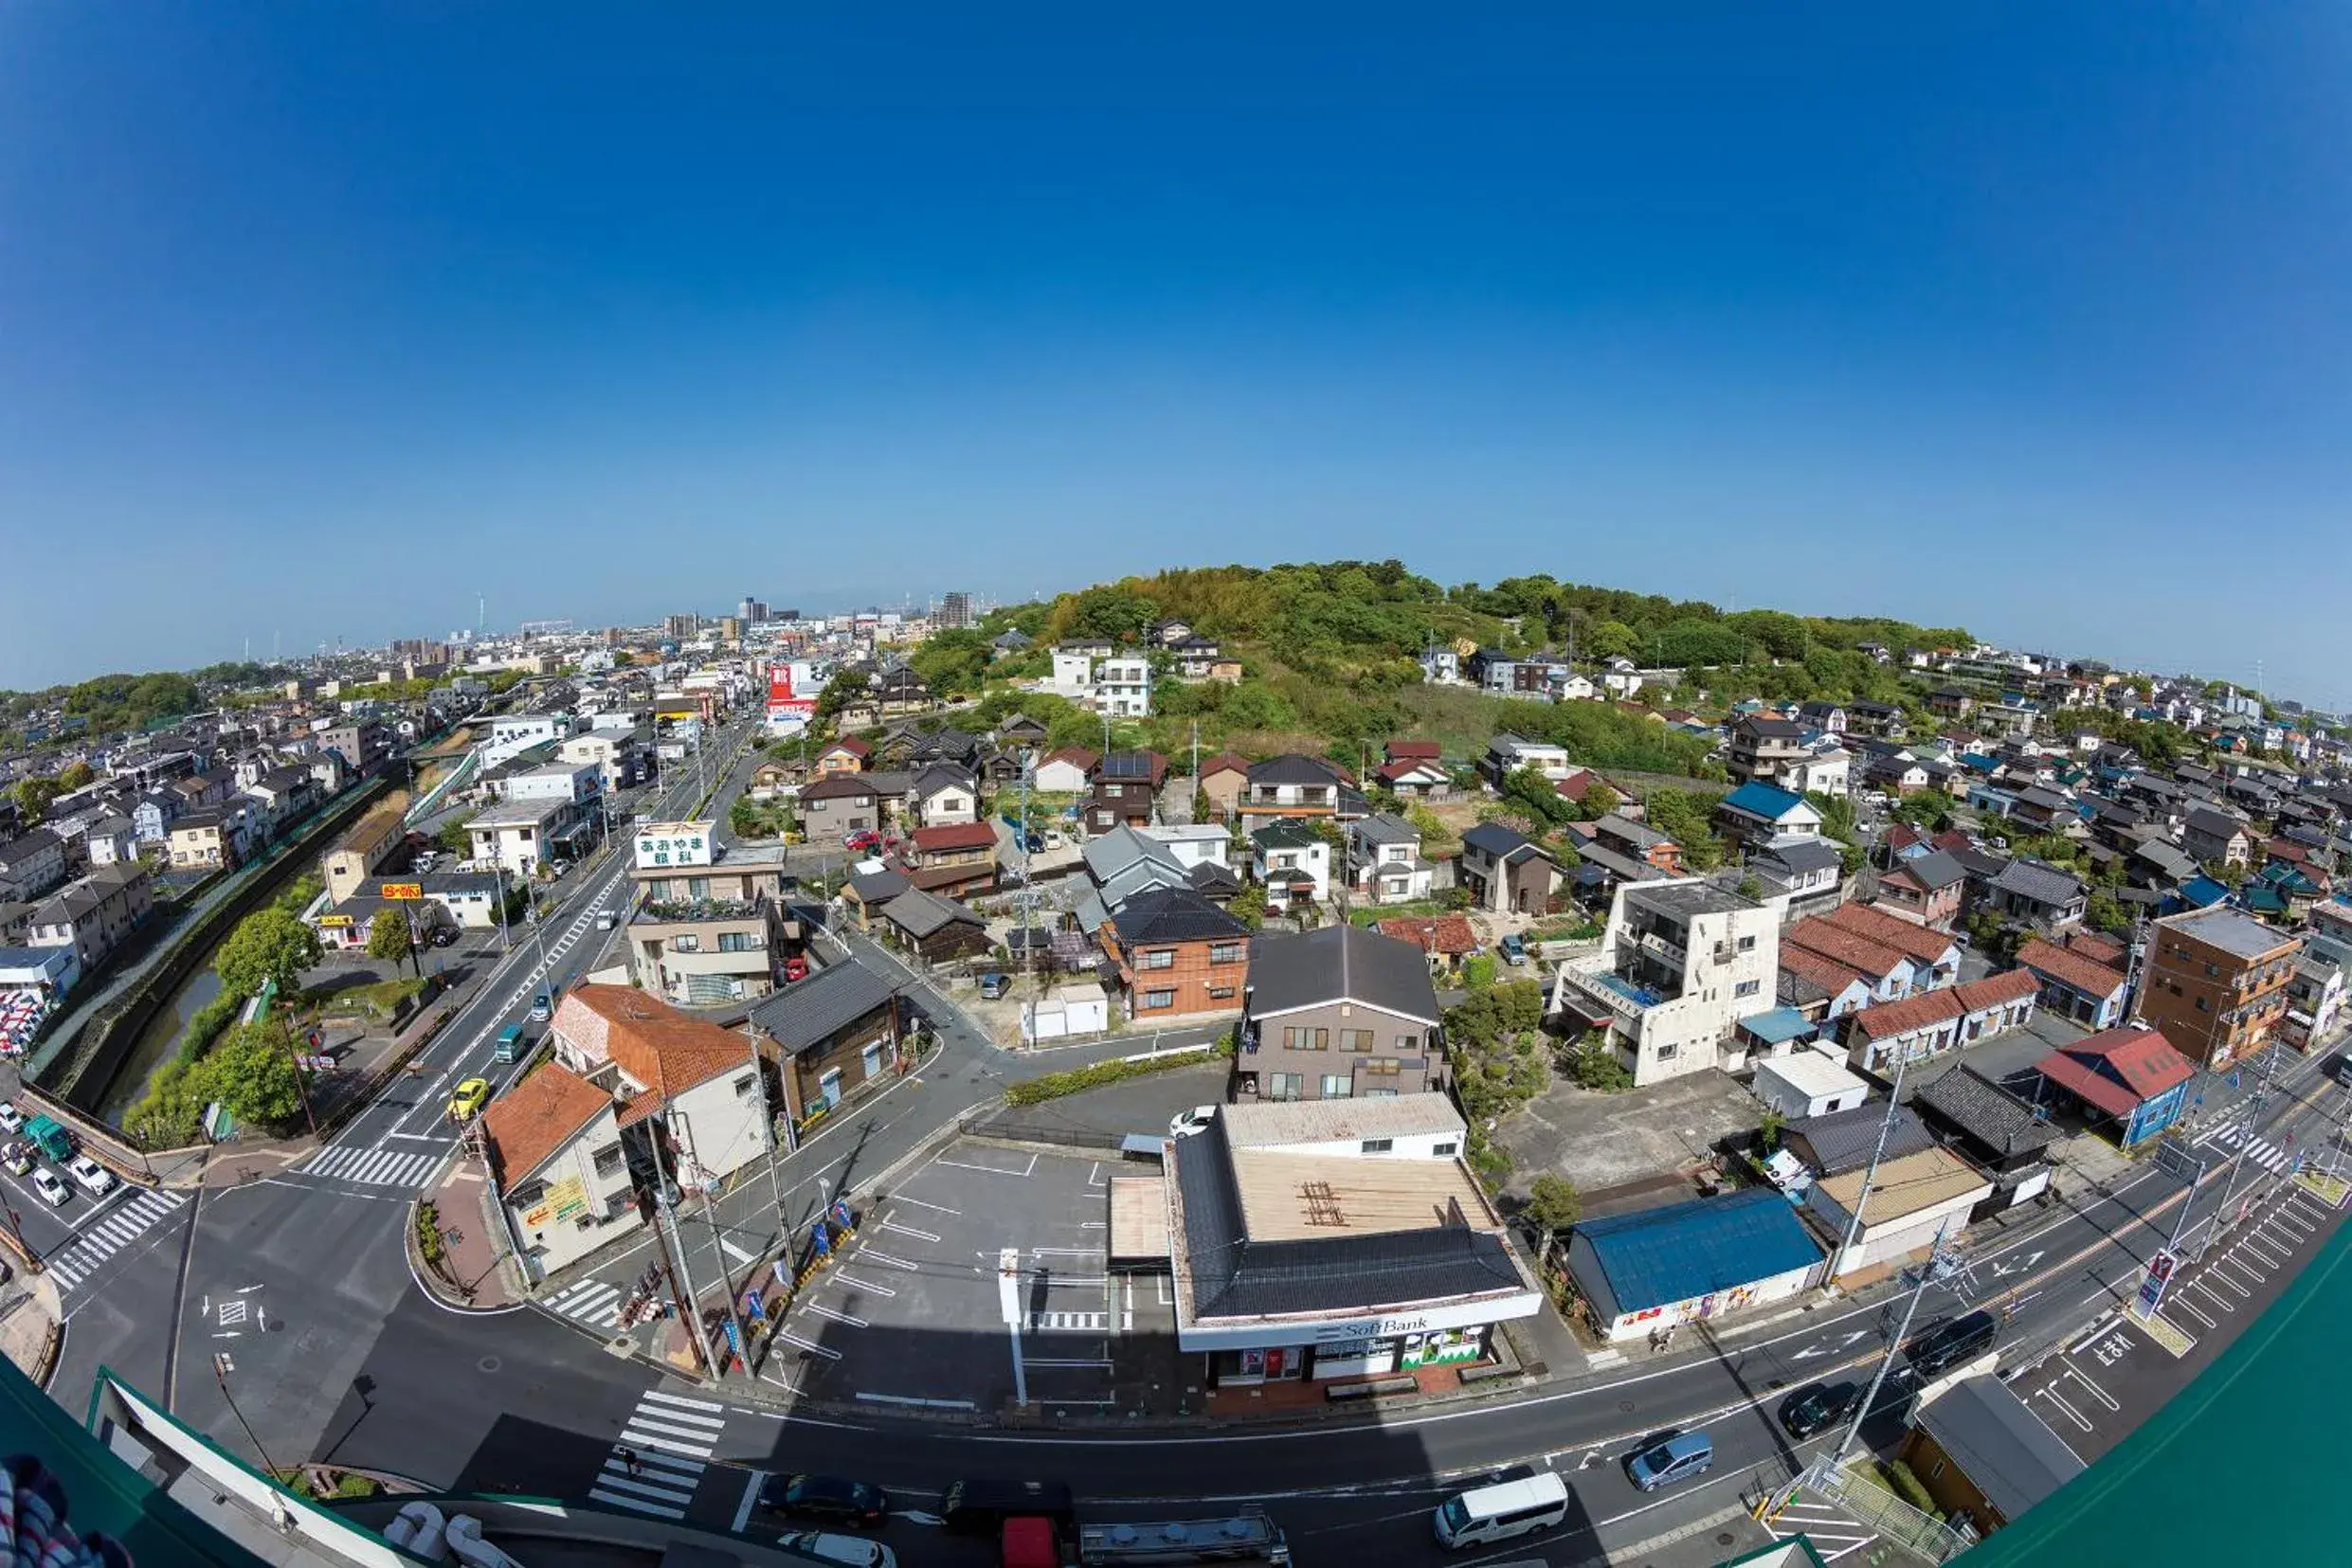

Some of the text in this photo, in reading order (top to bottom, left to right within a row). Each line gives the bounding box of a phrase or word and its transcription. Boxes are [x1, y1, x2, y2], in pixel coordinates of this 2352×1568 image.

[641, 838, 702, 852] あおやま
[655, 851, 692, 864] 眼科
[1346, 1317, 1428, 1337] SoftBank
[2092, 1332, 2136, 1366] 止まれ
